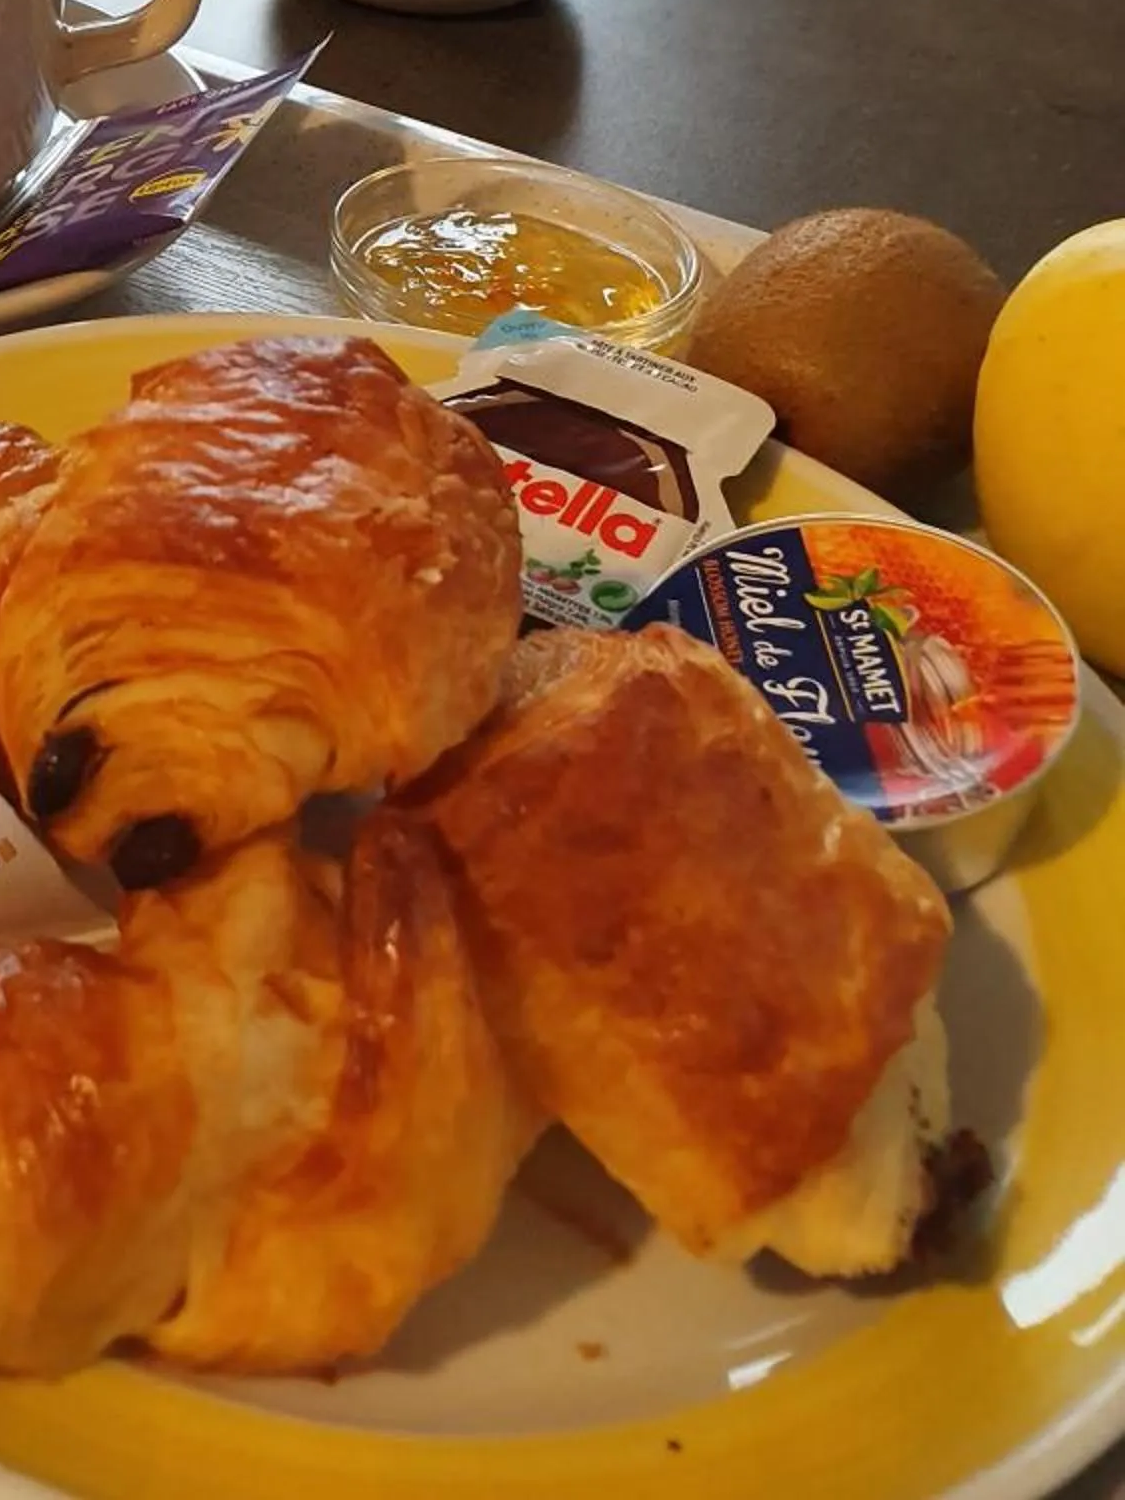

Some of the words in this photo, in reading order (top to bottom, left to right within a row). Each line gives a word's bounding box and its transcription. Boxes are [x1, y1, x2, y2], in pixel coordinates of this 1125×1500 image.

[503, 460, 659, 560] tella
[725, 546, 807, 634] Miel
[752, 640, 793, 670] de
[848, 633, 902, 715] MAMET
